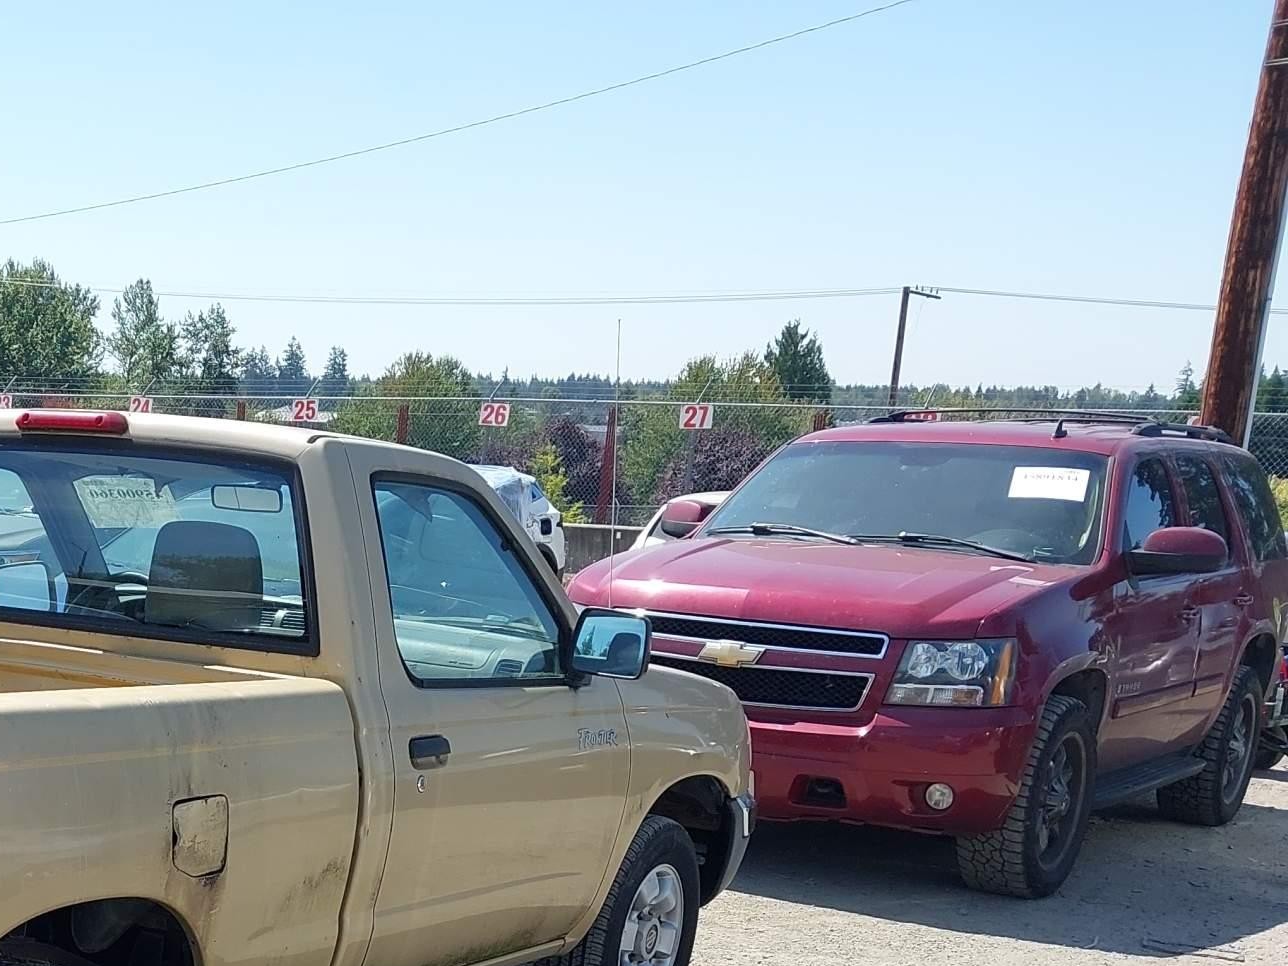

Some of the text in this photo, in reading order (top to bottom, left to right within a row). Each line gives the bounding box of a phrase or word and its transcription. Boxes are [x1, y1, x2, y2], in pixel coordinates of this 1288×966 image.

[294, 400, 317, 420] 25
[481, 404, 507, 425] 26
[683, 406, 709, 428] 27
